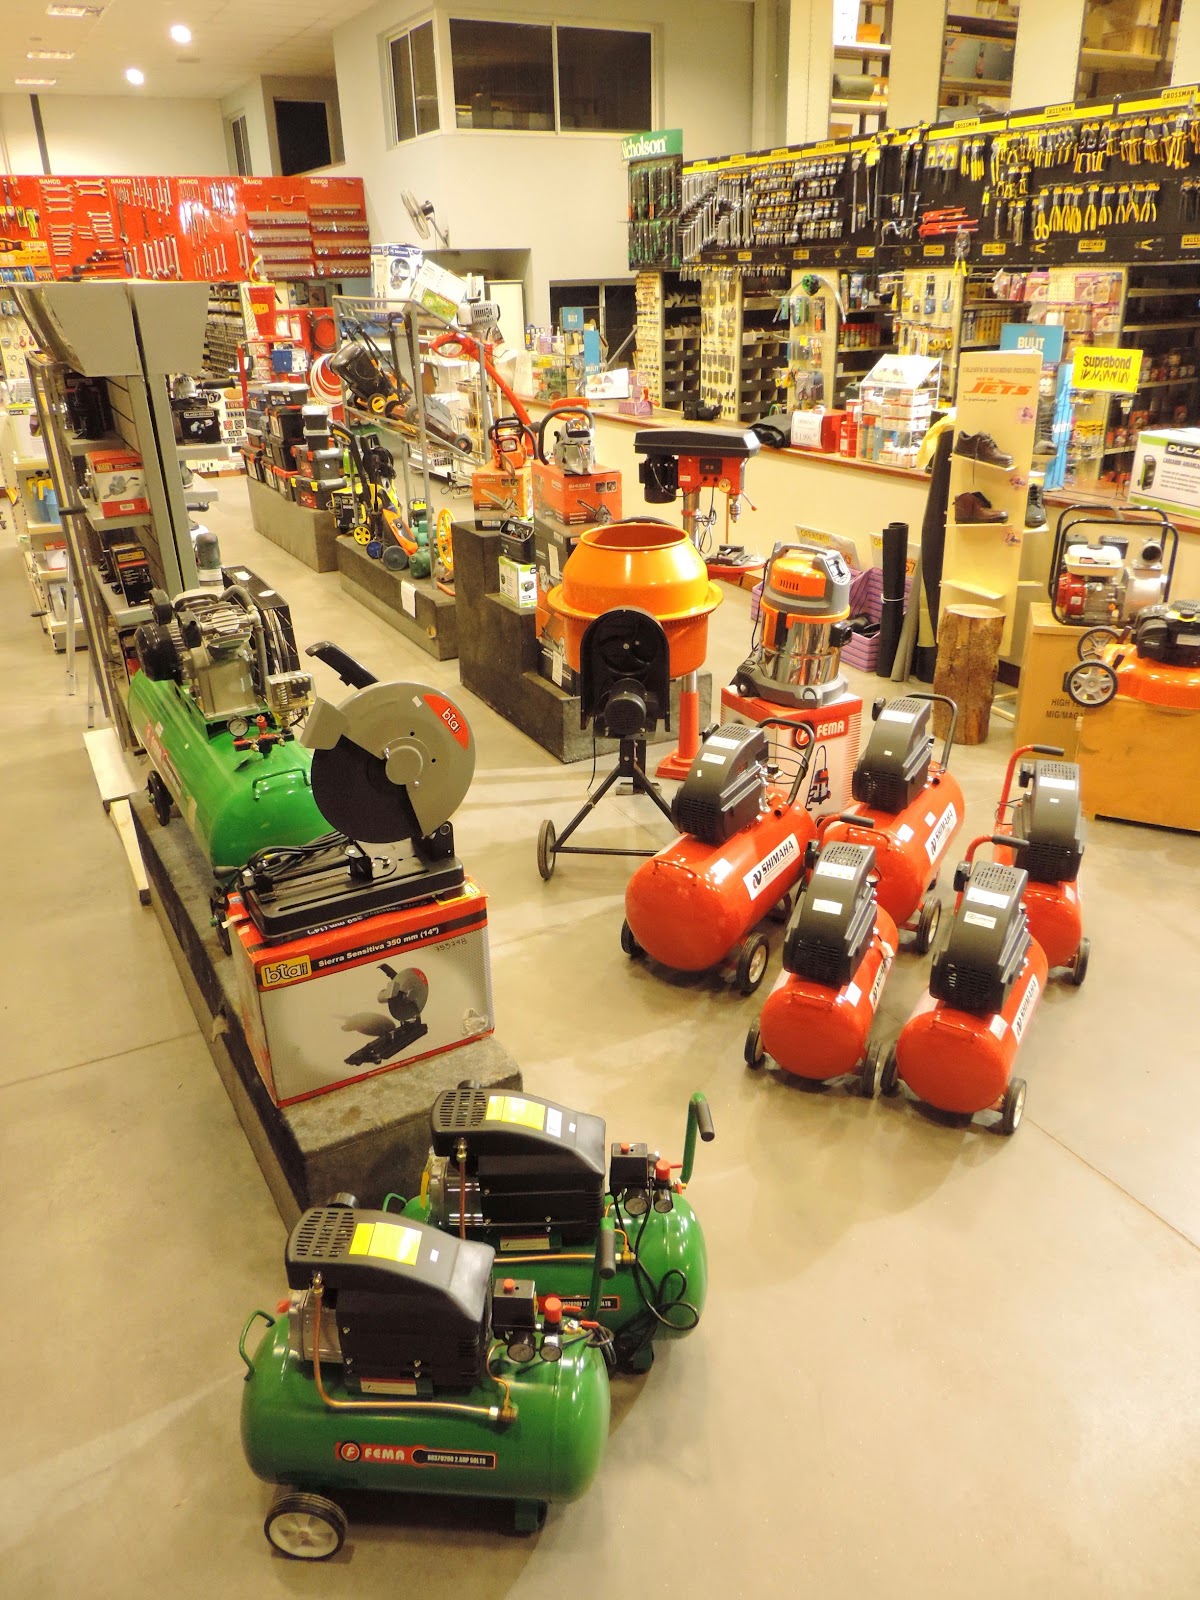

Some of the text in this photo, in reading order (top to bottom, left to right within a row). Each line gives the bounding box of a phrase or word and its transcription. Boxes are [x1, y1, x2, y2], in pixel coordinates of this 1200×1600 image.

[1163, 89, 1196, 100] CROSSMAN
[1046, 106, 1073, 114] CROSSMAN
[1017, 336, 1045, 350] BULIT
[963, 382, 1032, 395] JETS
[816, 720, 844, 738] FEMA
[761, 840, 794, 876] SHIMAHA
[318, 955, 345, 968] Sierra
[346, 943, 386, 960] Sensitiva
[386, 938, 402, 949] 350
[403, 933, 420, 944] mm
[365, 1447, 404, 1460] FEMA
